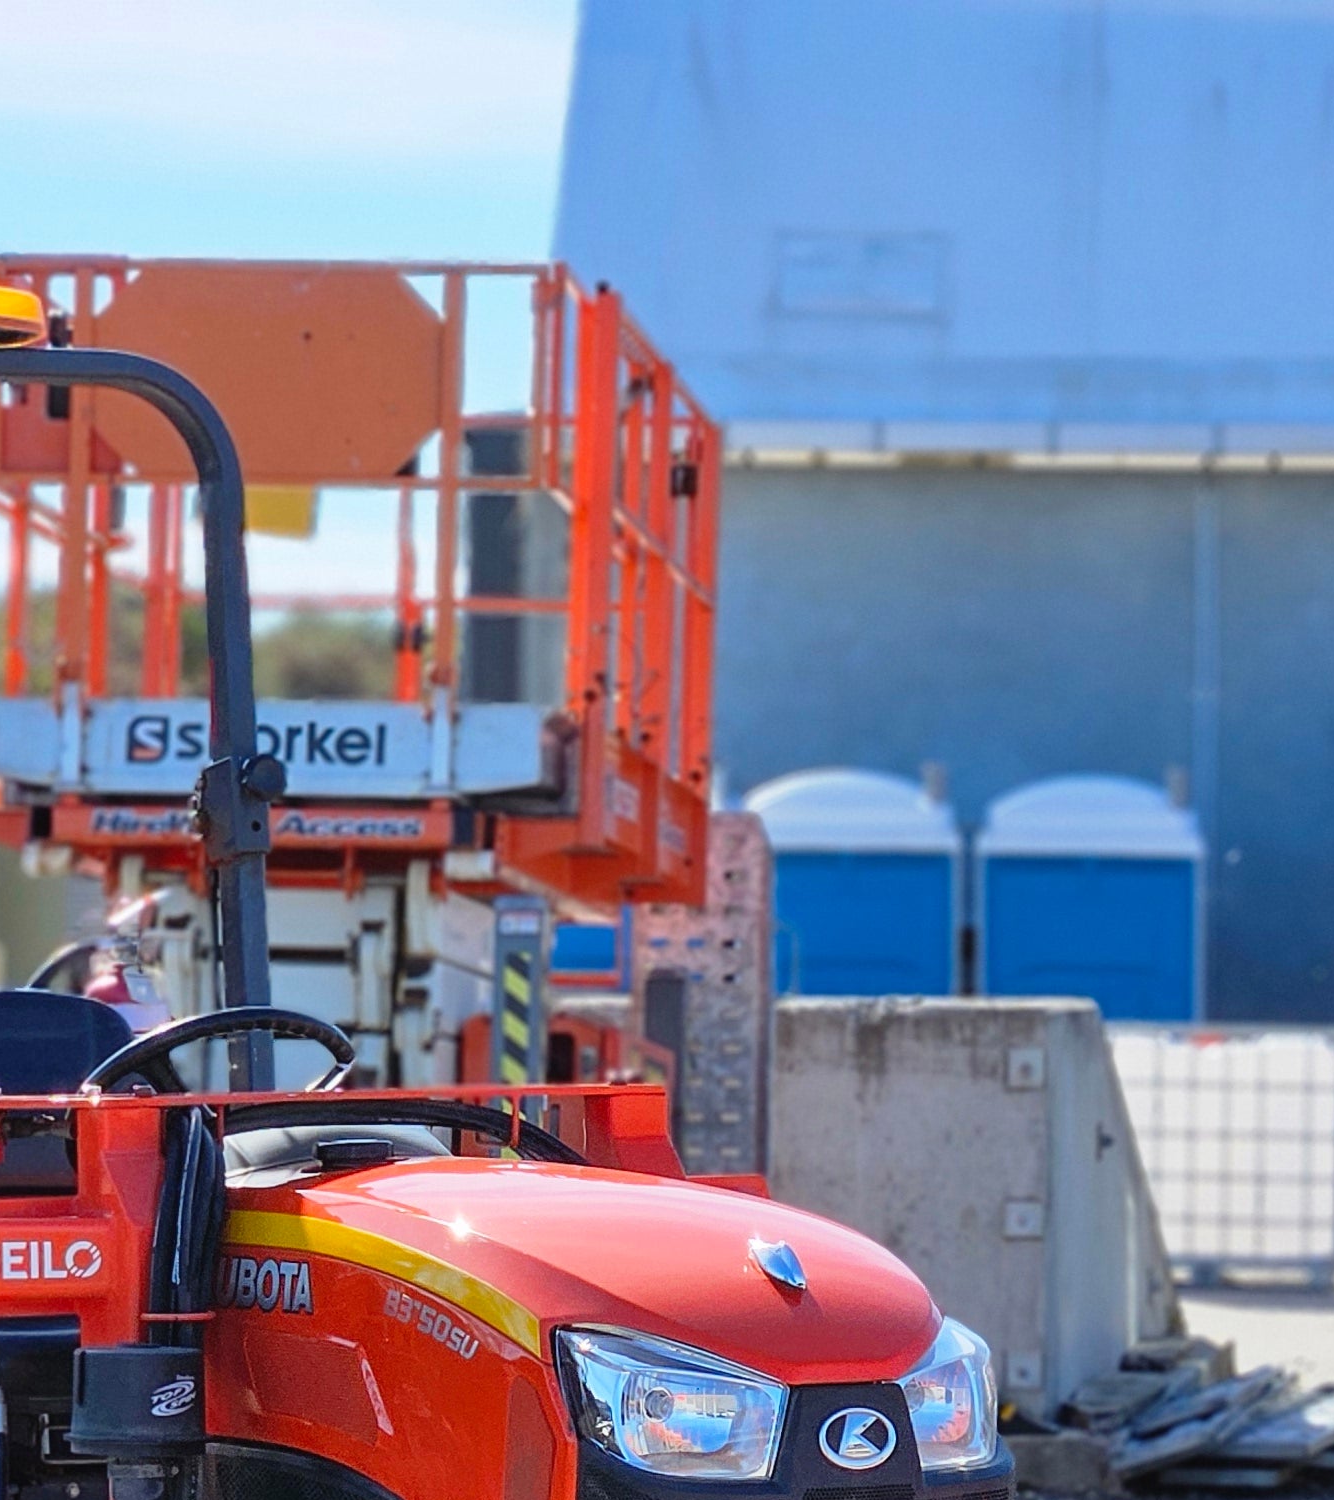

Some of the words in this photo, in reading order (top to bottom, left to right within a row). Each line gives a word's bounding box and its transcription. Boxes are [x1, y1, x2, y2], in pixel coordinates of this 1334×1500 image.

[176, 720, 387, 766] sorkel
[277, 810, 421, 838] Access
[217, 1257, 314, 1314] UBOTA
[383, 1288, 479, 1361] B350SU
